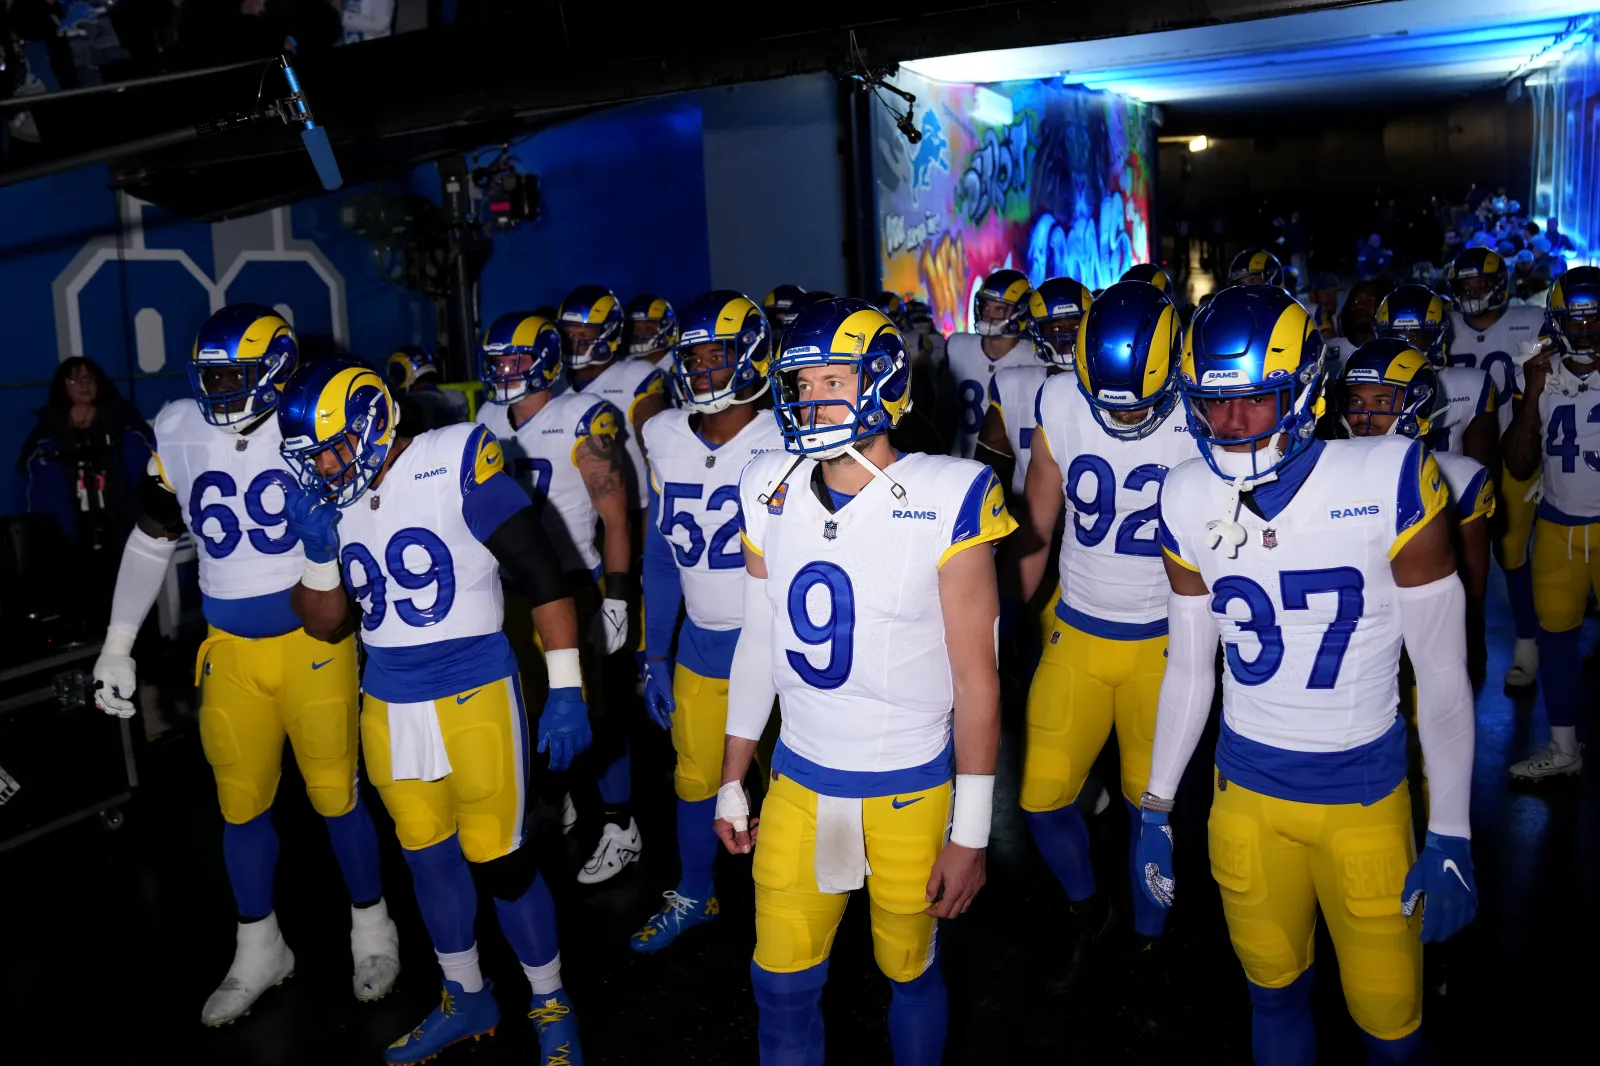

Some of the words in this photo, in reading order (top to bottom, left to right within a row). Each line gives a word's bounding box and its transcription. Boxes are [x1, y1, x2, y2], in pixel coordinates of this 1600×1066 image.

[1208, 371, 1239, 379] RAMS
[189, 468, 302, 559] 69
[414, 466, 447, 481] RAMS
[892, 509, 937, 521] RAMS
[1066, 453, 1163, 557] 92
[1329, 505, 1380, 520] RAMS
[660, 481, 746, 571] 52
[341, 526, 456, 632] 99
[785, 560, 856, 690] 9
[1211, 565, 1365, 690] 37
